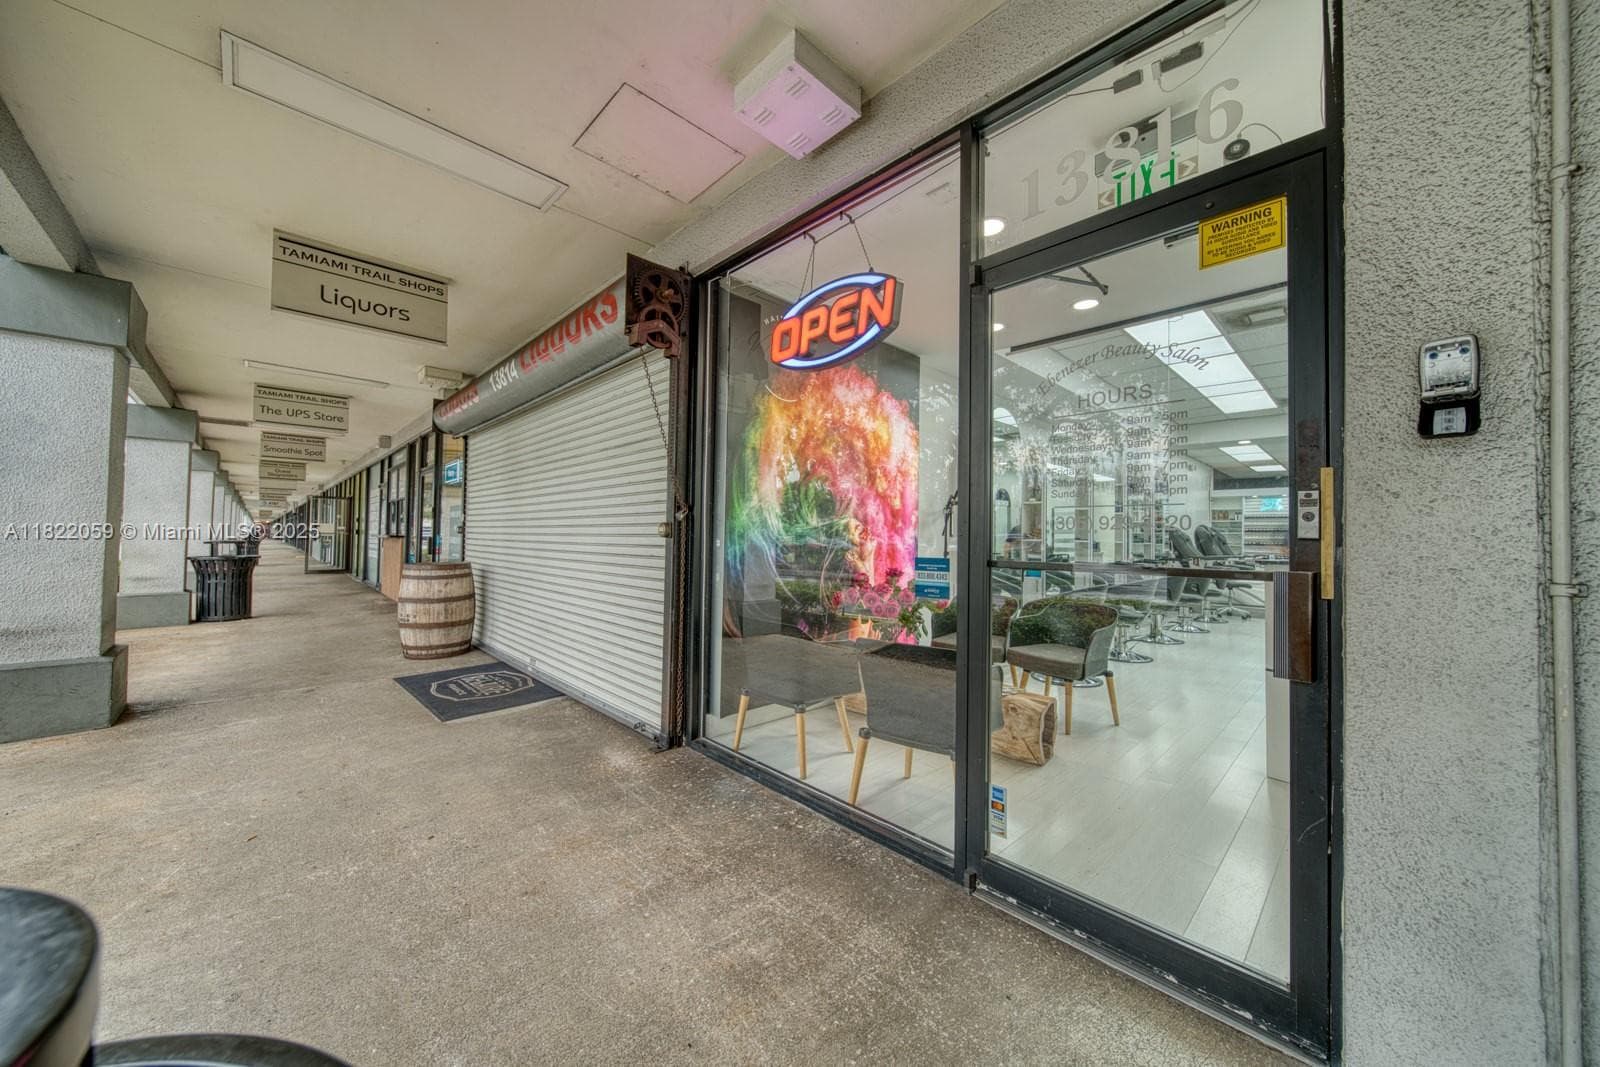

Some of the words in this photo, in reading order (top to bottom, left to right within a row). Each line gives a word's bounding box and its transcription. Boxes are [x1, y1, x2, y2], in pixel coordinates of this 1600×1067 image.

[1022, 78, 1243, 222] 13816
[1211, 207, 1272, 233] WARNING
[279, 245, 348, 271] TAMIAMI
[352, 264, 395, 284] TRAIL
[399, 278, 444, 297] SHOPS
[320, 284, 410, 322] Liquors
[771, 277, 897, 363] OPEN
[488, 359, 519, 392] 13814
[519, 290, 618, 374] LIQUORS
[1037, 351, 1100, 396] Ebenezer
[1100, 342, 1161, 360] Beauty
[1161, 342, 1210, 371] Salon
[257, 389, 293, 400] TAMIAMI
[295, 394, 320, 402] TRAIL
[320, 398, 348, 406] SHOPS
[1077, 384, 1153, 408] HOURS
[259, 404, 282, 416] The
[286, 408, 311, 419] UPS
[313, 411, 345, 423] Store
[1162, 422, 1188, 434] 7pm
[263, 445, 302, 455] Smoothie
[304, 446, 323, 457] Spot
[1162, 448, 1188, 460] 7pm
[1162, 461, 1188, 472] 7pm
